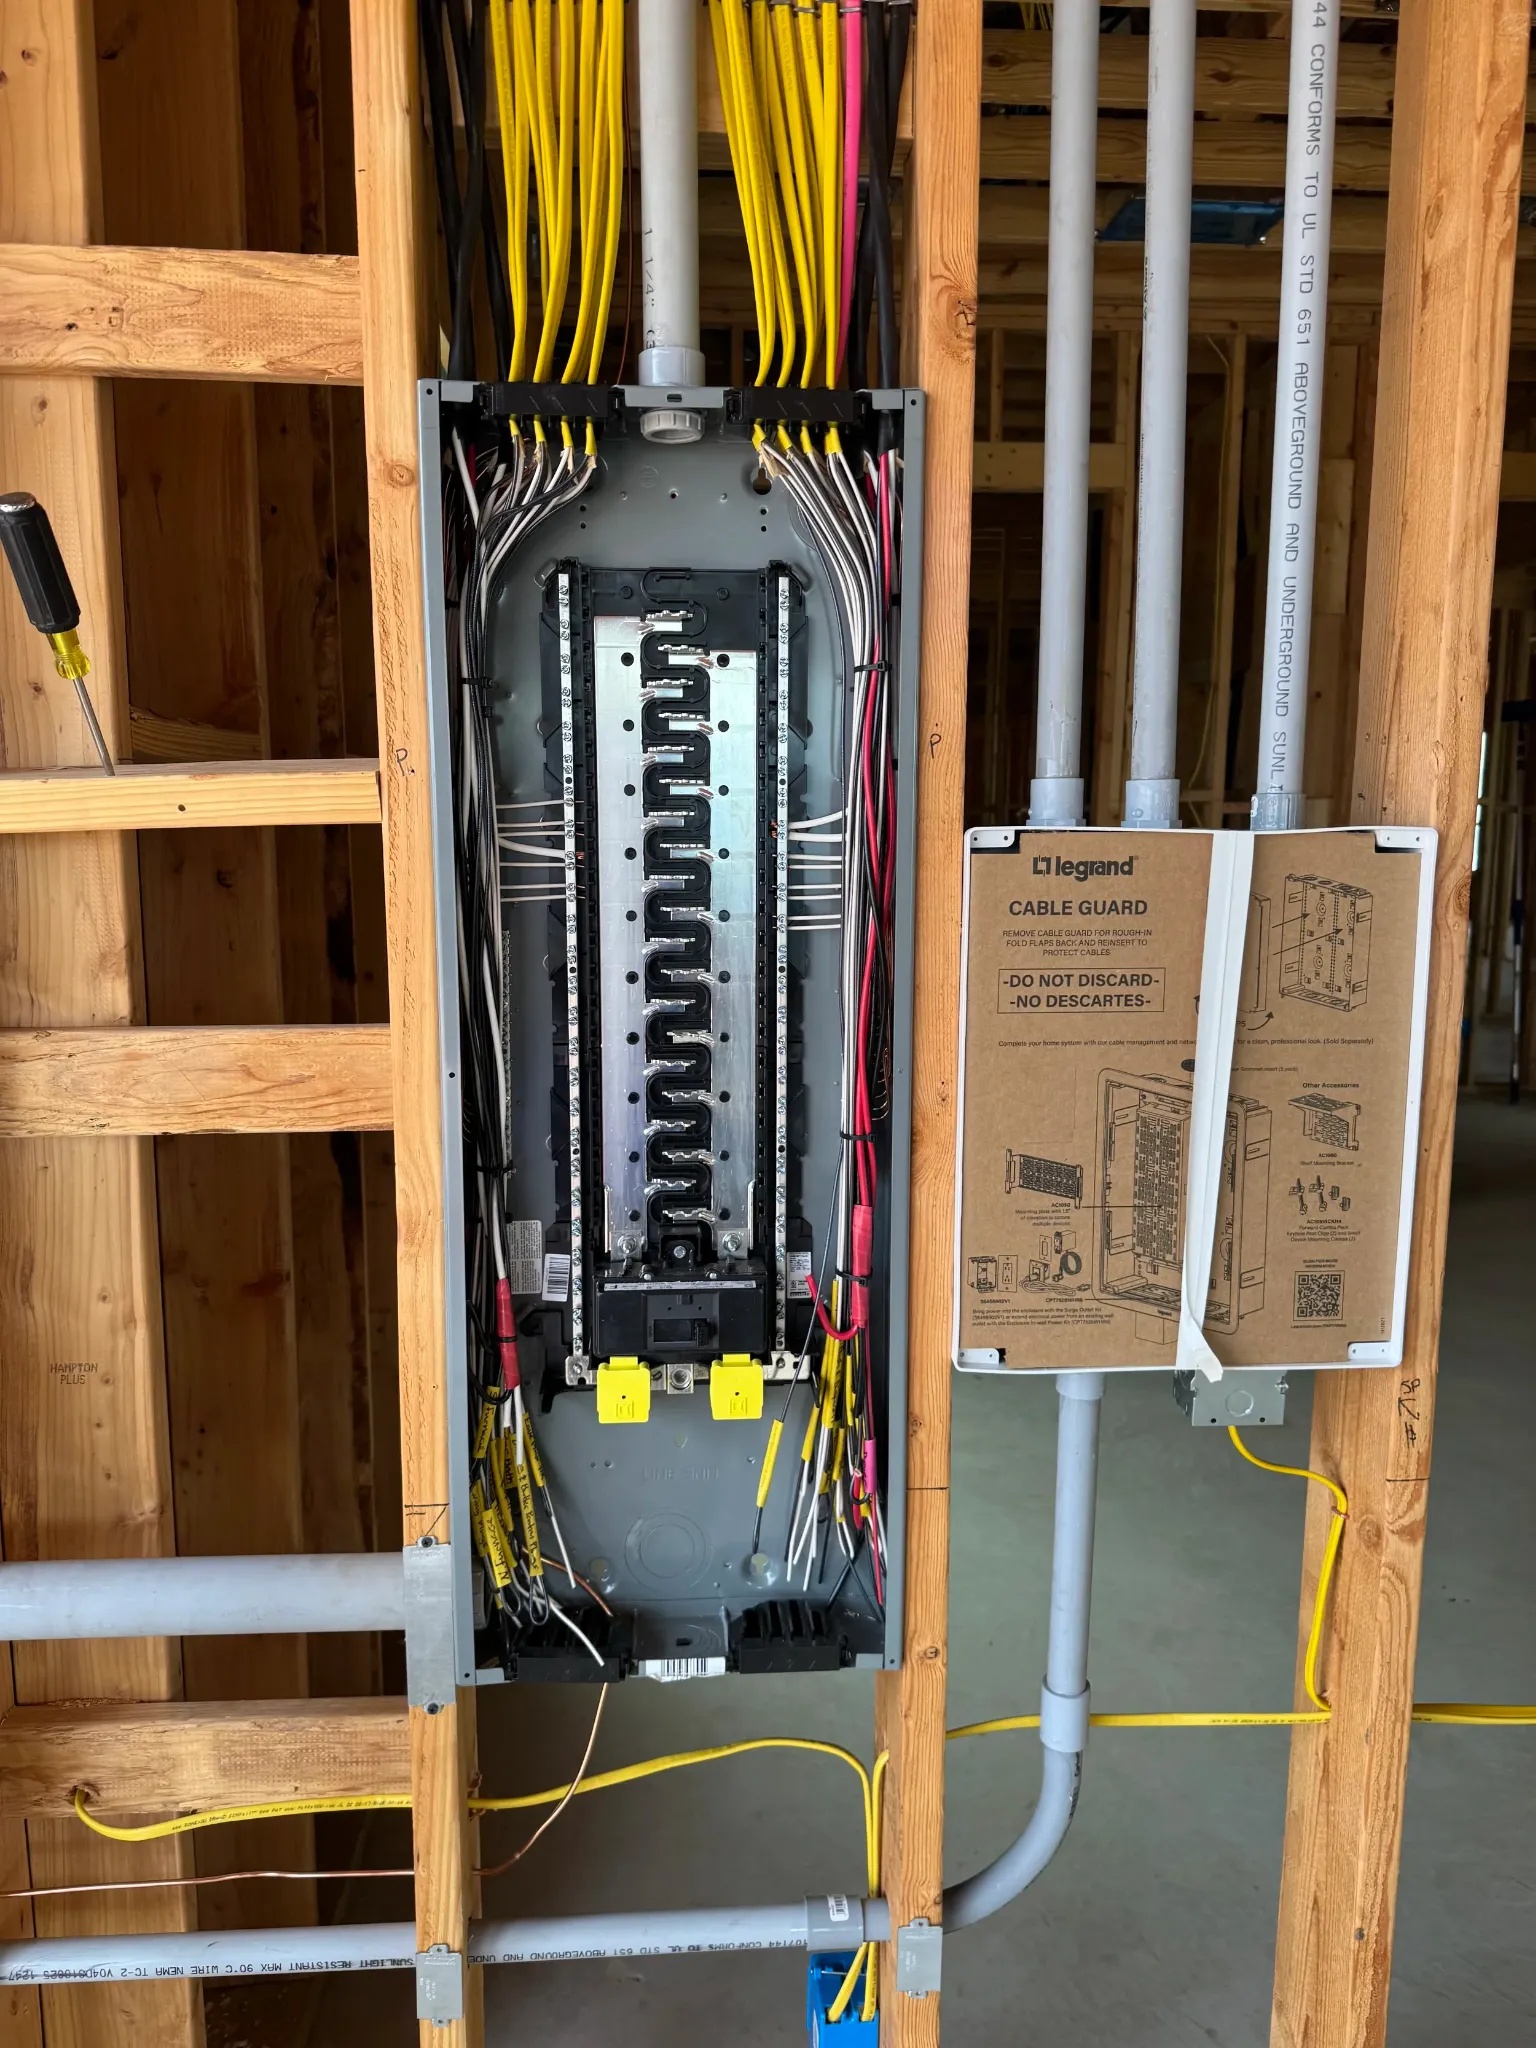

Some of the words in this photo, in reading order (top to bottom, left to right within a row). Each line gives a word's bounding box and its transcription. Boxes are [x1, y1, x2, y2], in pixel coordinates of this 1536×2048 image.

[1305, 44, 1326, 156] CONFORMS
[1303, 172, 1319, 198] TO
[1302, 213, 1317, 239] UL
[1299, 255, 1315, 294] STD
[1297, 308, 1312, 345] 651
[1287, 362, 1309, 510] ABOVEGROUND
[1284, 523, 1300, 562] AND
[1275, 576, 1297, 717] UNDERGROUND
[930, 733, 942, 759] P
[395, 748, 408, 777] P
[1055, 856, 1134, 882] legrand
[1009, 900, 1073, 915] CABLE
[1078, 899, 1148, 915] GUARD
[1037, 929, 1063, 937] CABLE
[1064, 929, 1093, 937] GUARD
[1094, 929, 1111, 937] FOR
[1112, 929, 1153, 937] ROUGH-IN
[1006, 939, 1028, 947] FOLD
[1029, 939, 1054, 947] FLAPS
[1055, 939, 1077, 947] BACK
[1097, 938, 1135, 946] REINSERT
[1136, 938, 1148, 946] TO
[1080, 948, 1111, 956] CABLES
[1003, 974, 1034, 988] -DO
[1039, 974, 1074, 987] NOT
[1078, 973, 1160, 987] DISCARD-
[1009, 995, 1042, 1008] -NO
[1046, 993, 1151, 1008] DESCARTES-
[1061, 1040, 1083, 1048] system
[1126, 1039, 1165, 1047] management
[1252, 1038, 1269, 1046] clean,
[1270, 1038, 1307, 1046] professional
[1323, 1037, 1339, 1046] (Sold
[50, 1362, 98, 1373] HAMPTON
[60, 1374, 86, 1385] PLUS
[530, 1949, 607, 1960] ABOVEGROUND
[613, 1947, 633, 1956] 651
[640, 1946, 661, 1954] STD
[503, 1953, 524, 1961] AND
[261, 1963, 282, 1972] MAX
[289, 1960, 352, 1972] RESISTANT
[358, 1958, 414, 1969] SUNLIGHT
[120, 1968, 149, 1977] TC-2
[155, 1966, 184, 1975] NEMA
[190, 1965, 219, 1974] WIRE
